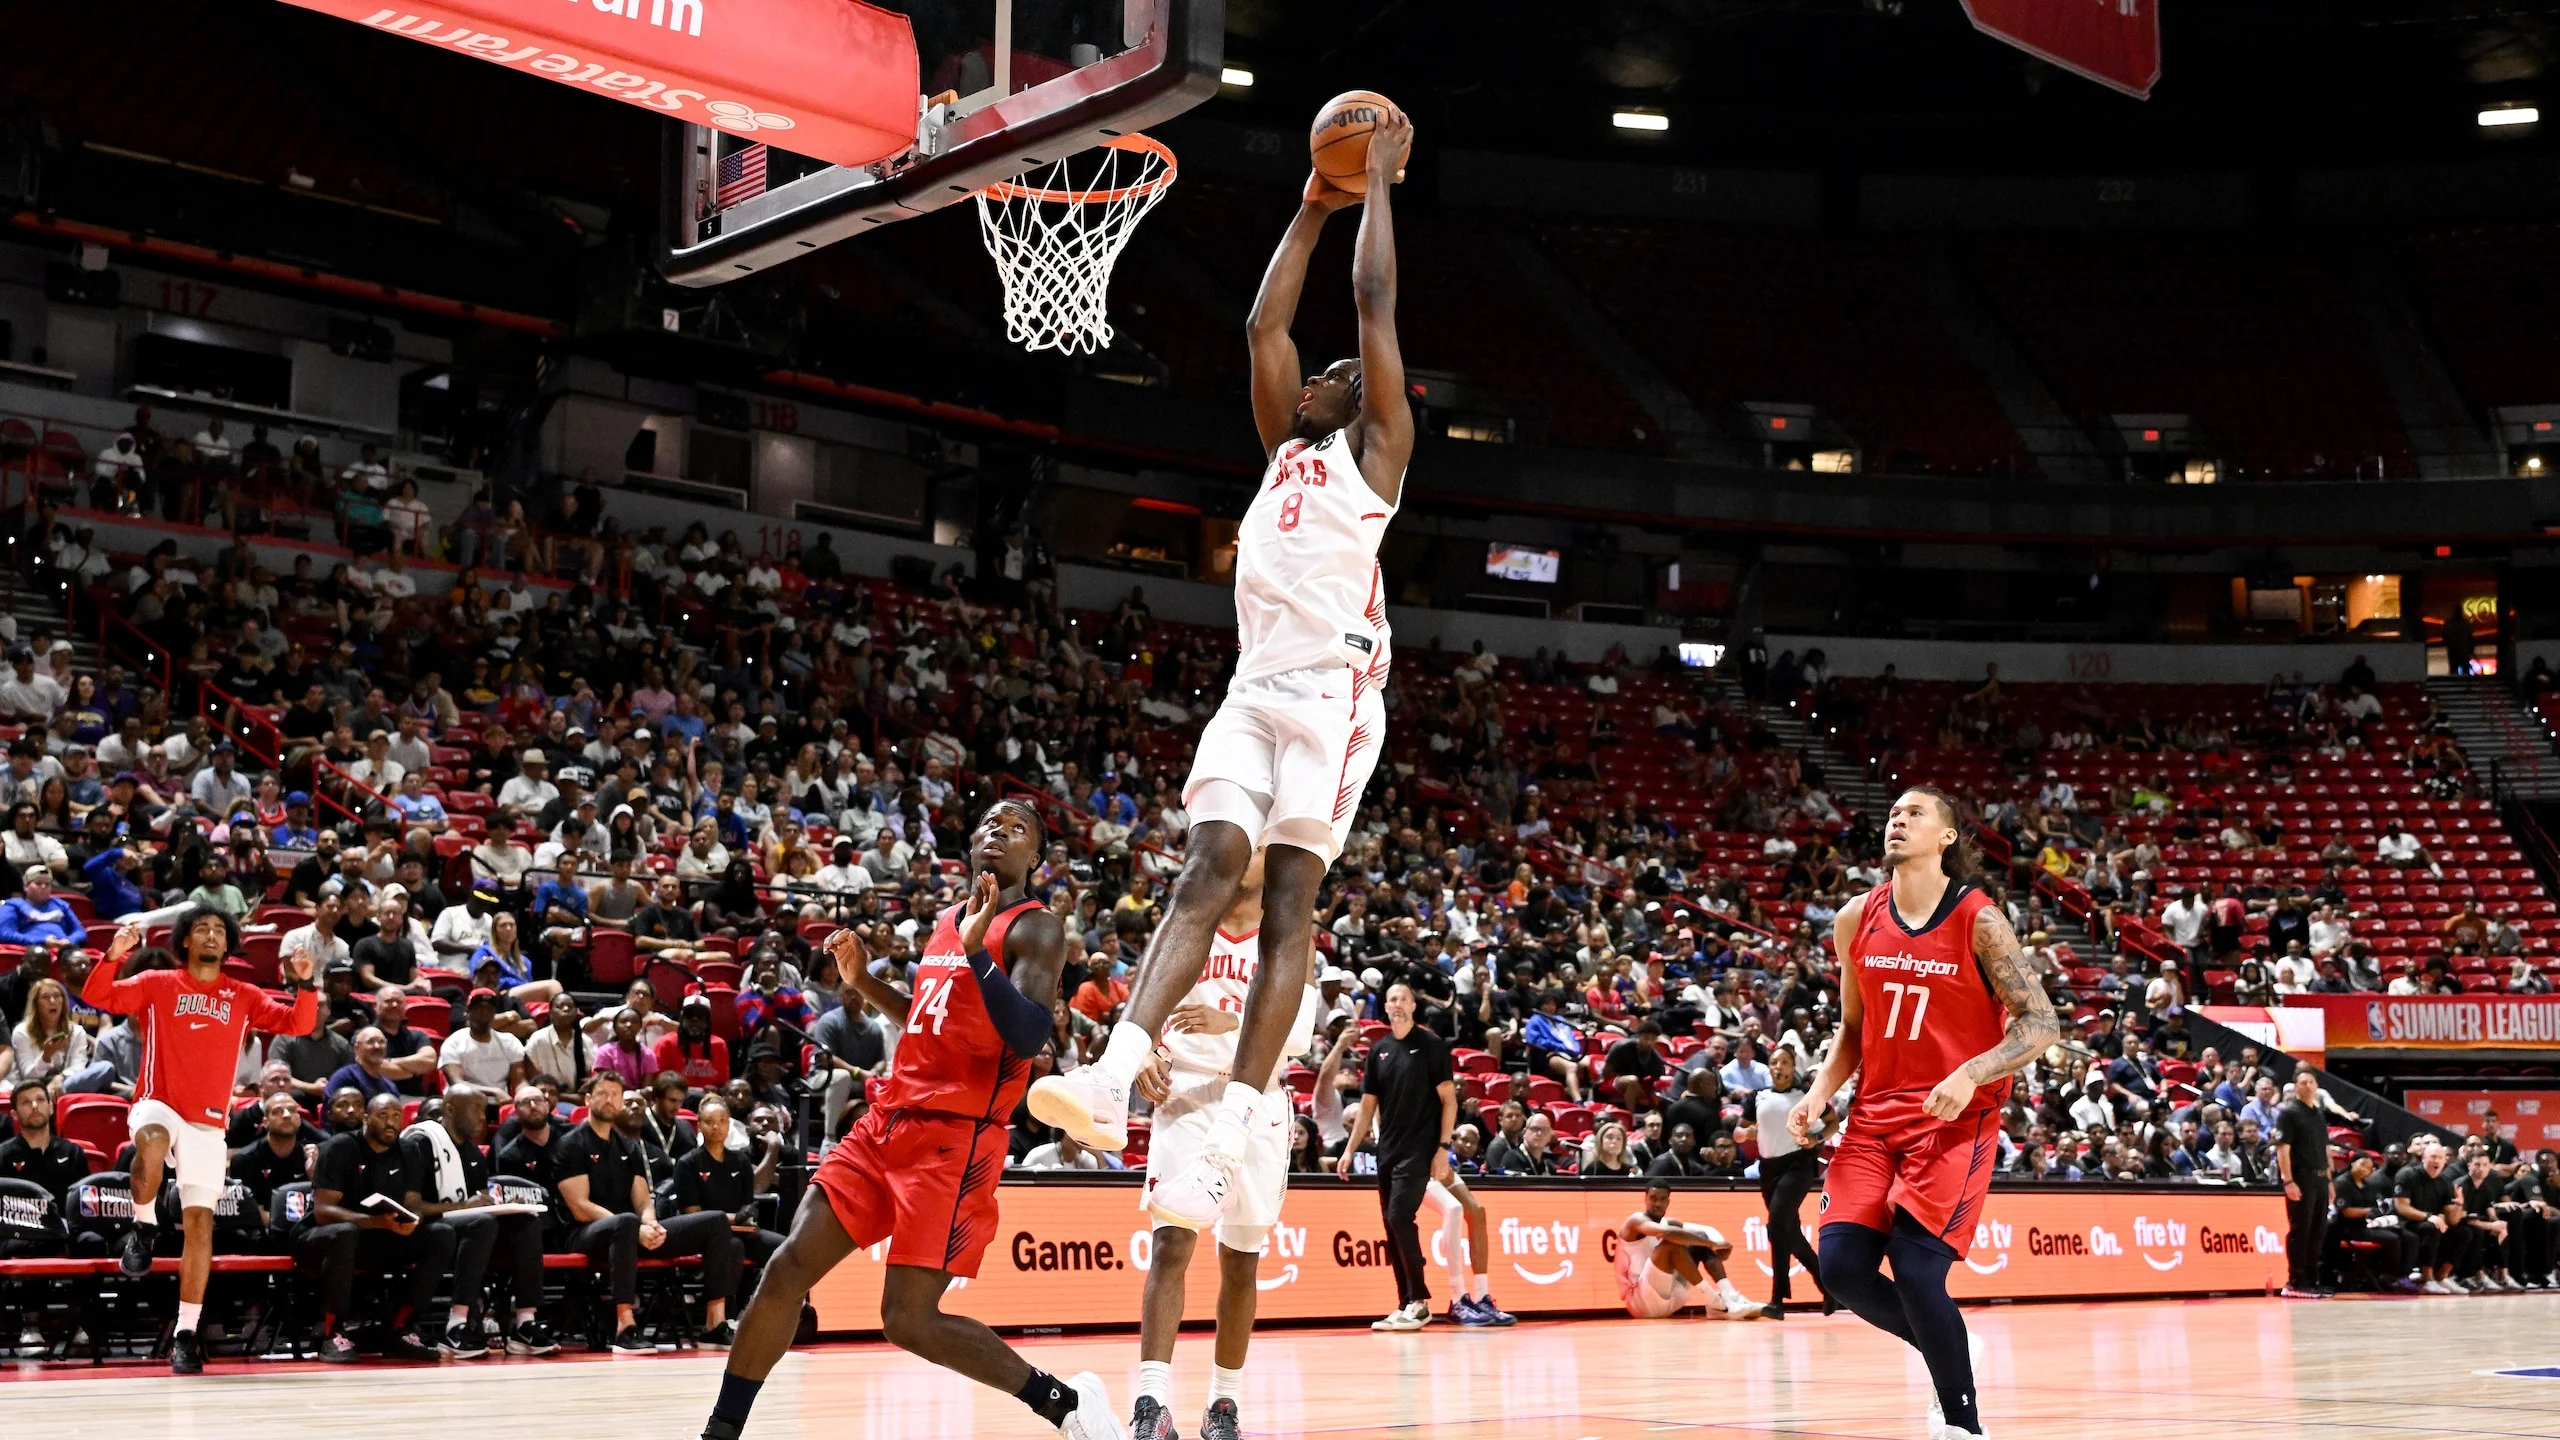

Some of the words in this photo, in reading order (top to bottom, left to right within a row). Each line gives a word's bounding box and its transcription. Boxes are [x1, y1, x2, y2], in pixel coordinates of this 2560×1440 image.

[707, 222, 712, 234] 5
[159, 278, 218, 319] 117
[666, 312, 676, 328] 7
[757, 401, 798, 431] 118
[1278, 492, 1303, 532] 8
[759, 523, 800, 557] 118
[2067, 651, 2111, 678] 120
[1864, 951, 1959, 978] washington
[174, 994, 231, 1025] BULLS
[907, 978, 953, 1035] 24
[1883, 982, 1930, 1040] 77
[2388, 1002, 2482, 1041] SUMMER
[214, 1199, 240, 1216] AGUE
[1012, 1231, 1123, 1271] Game.
[1274, 1221, 1307, 1257] tv
[1499, 1217, 1548, 1255] fire
[1551, 1220, 1580, 1254] tv
[1990, 1218, 2012, 1249] tv
[2029, 1227, 2088, 1256] Game.
[2090, 1225, 2123, 1256] On.
[2133, 1216, 2167, 1247] fire
[2167, 1217, 2187, 1247] tv
[2200, 1226, 2253, 1254] Game.
[2254, 1225, 2283, 1254] On.
